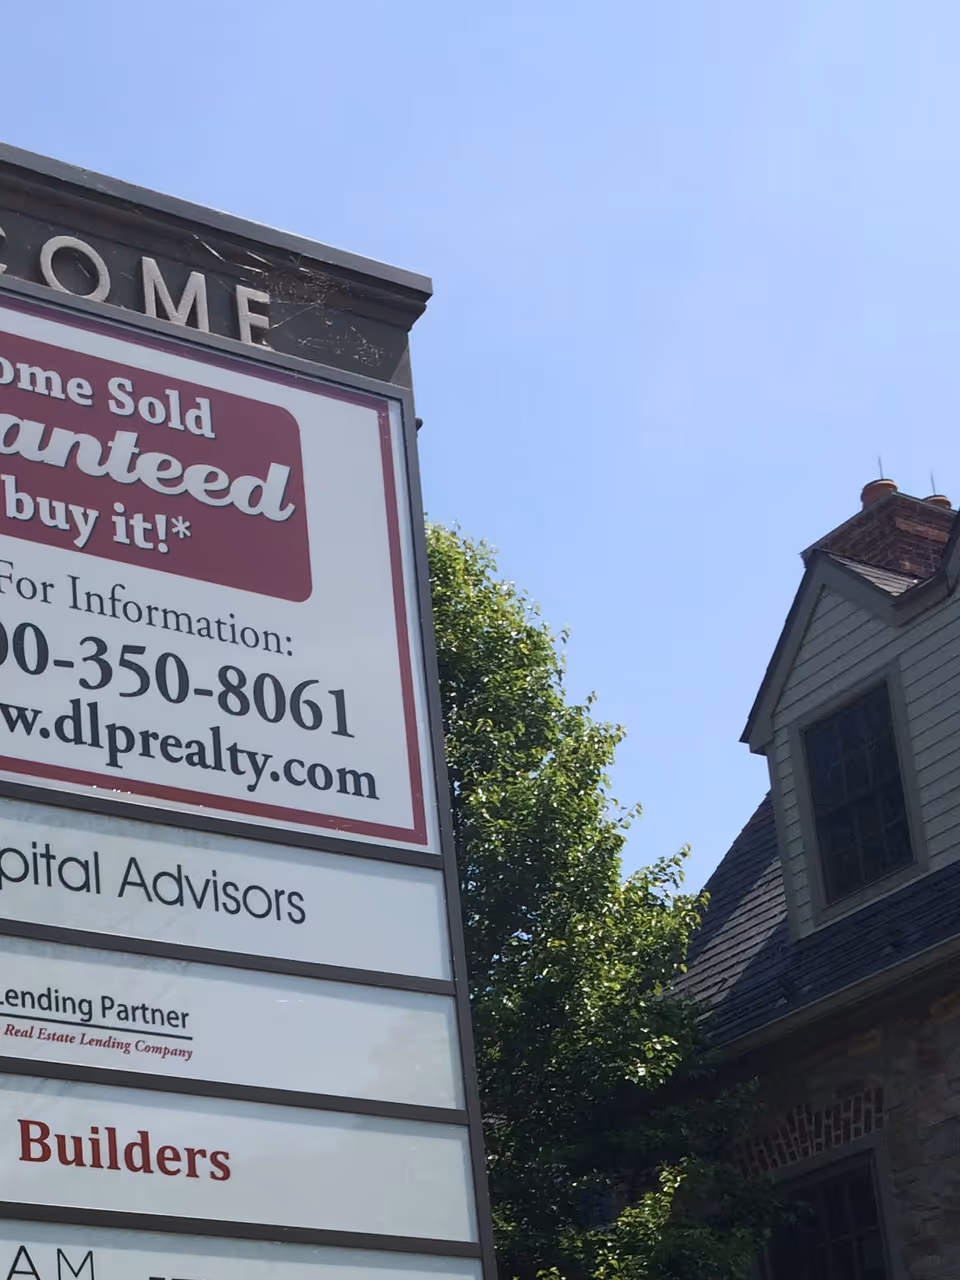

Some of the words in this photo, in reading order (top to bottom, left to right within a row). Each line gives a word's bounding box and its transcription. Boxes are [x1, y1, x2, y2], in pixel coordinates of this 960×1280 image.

[108, 378, 216, 440] Sold
[4, 472, 99, 549] buy
[69, 575, 294, 657] Information:
[117, 856, 306, 924] Advisors
[4, 1024, 34, 1039] Real
[37, 1028, 76, 1045] Estate
[80, 1033, 131, 1055] Lending
[135, 1040, 193, 1061] Company
[101, 996, 190, 1029] Partner
[17, 1119, 231, 1181] Builders
